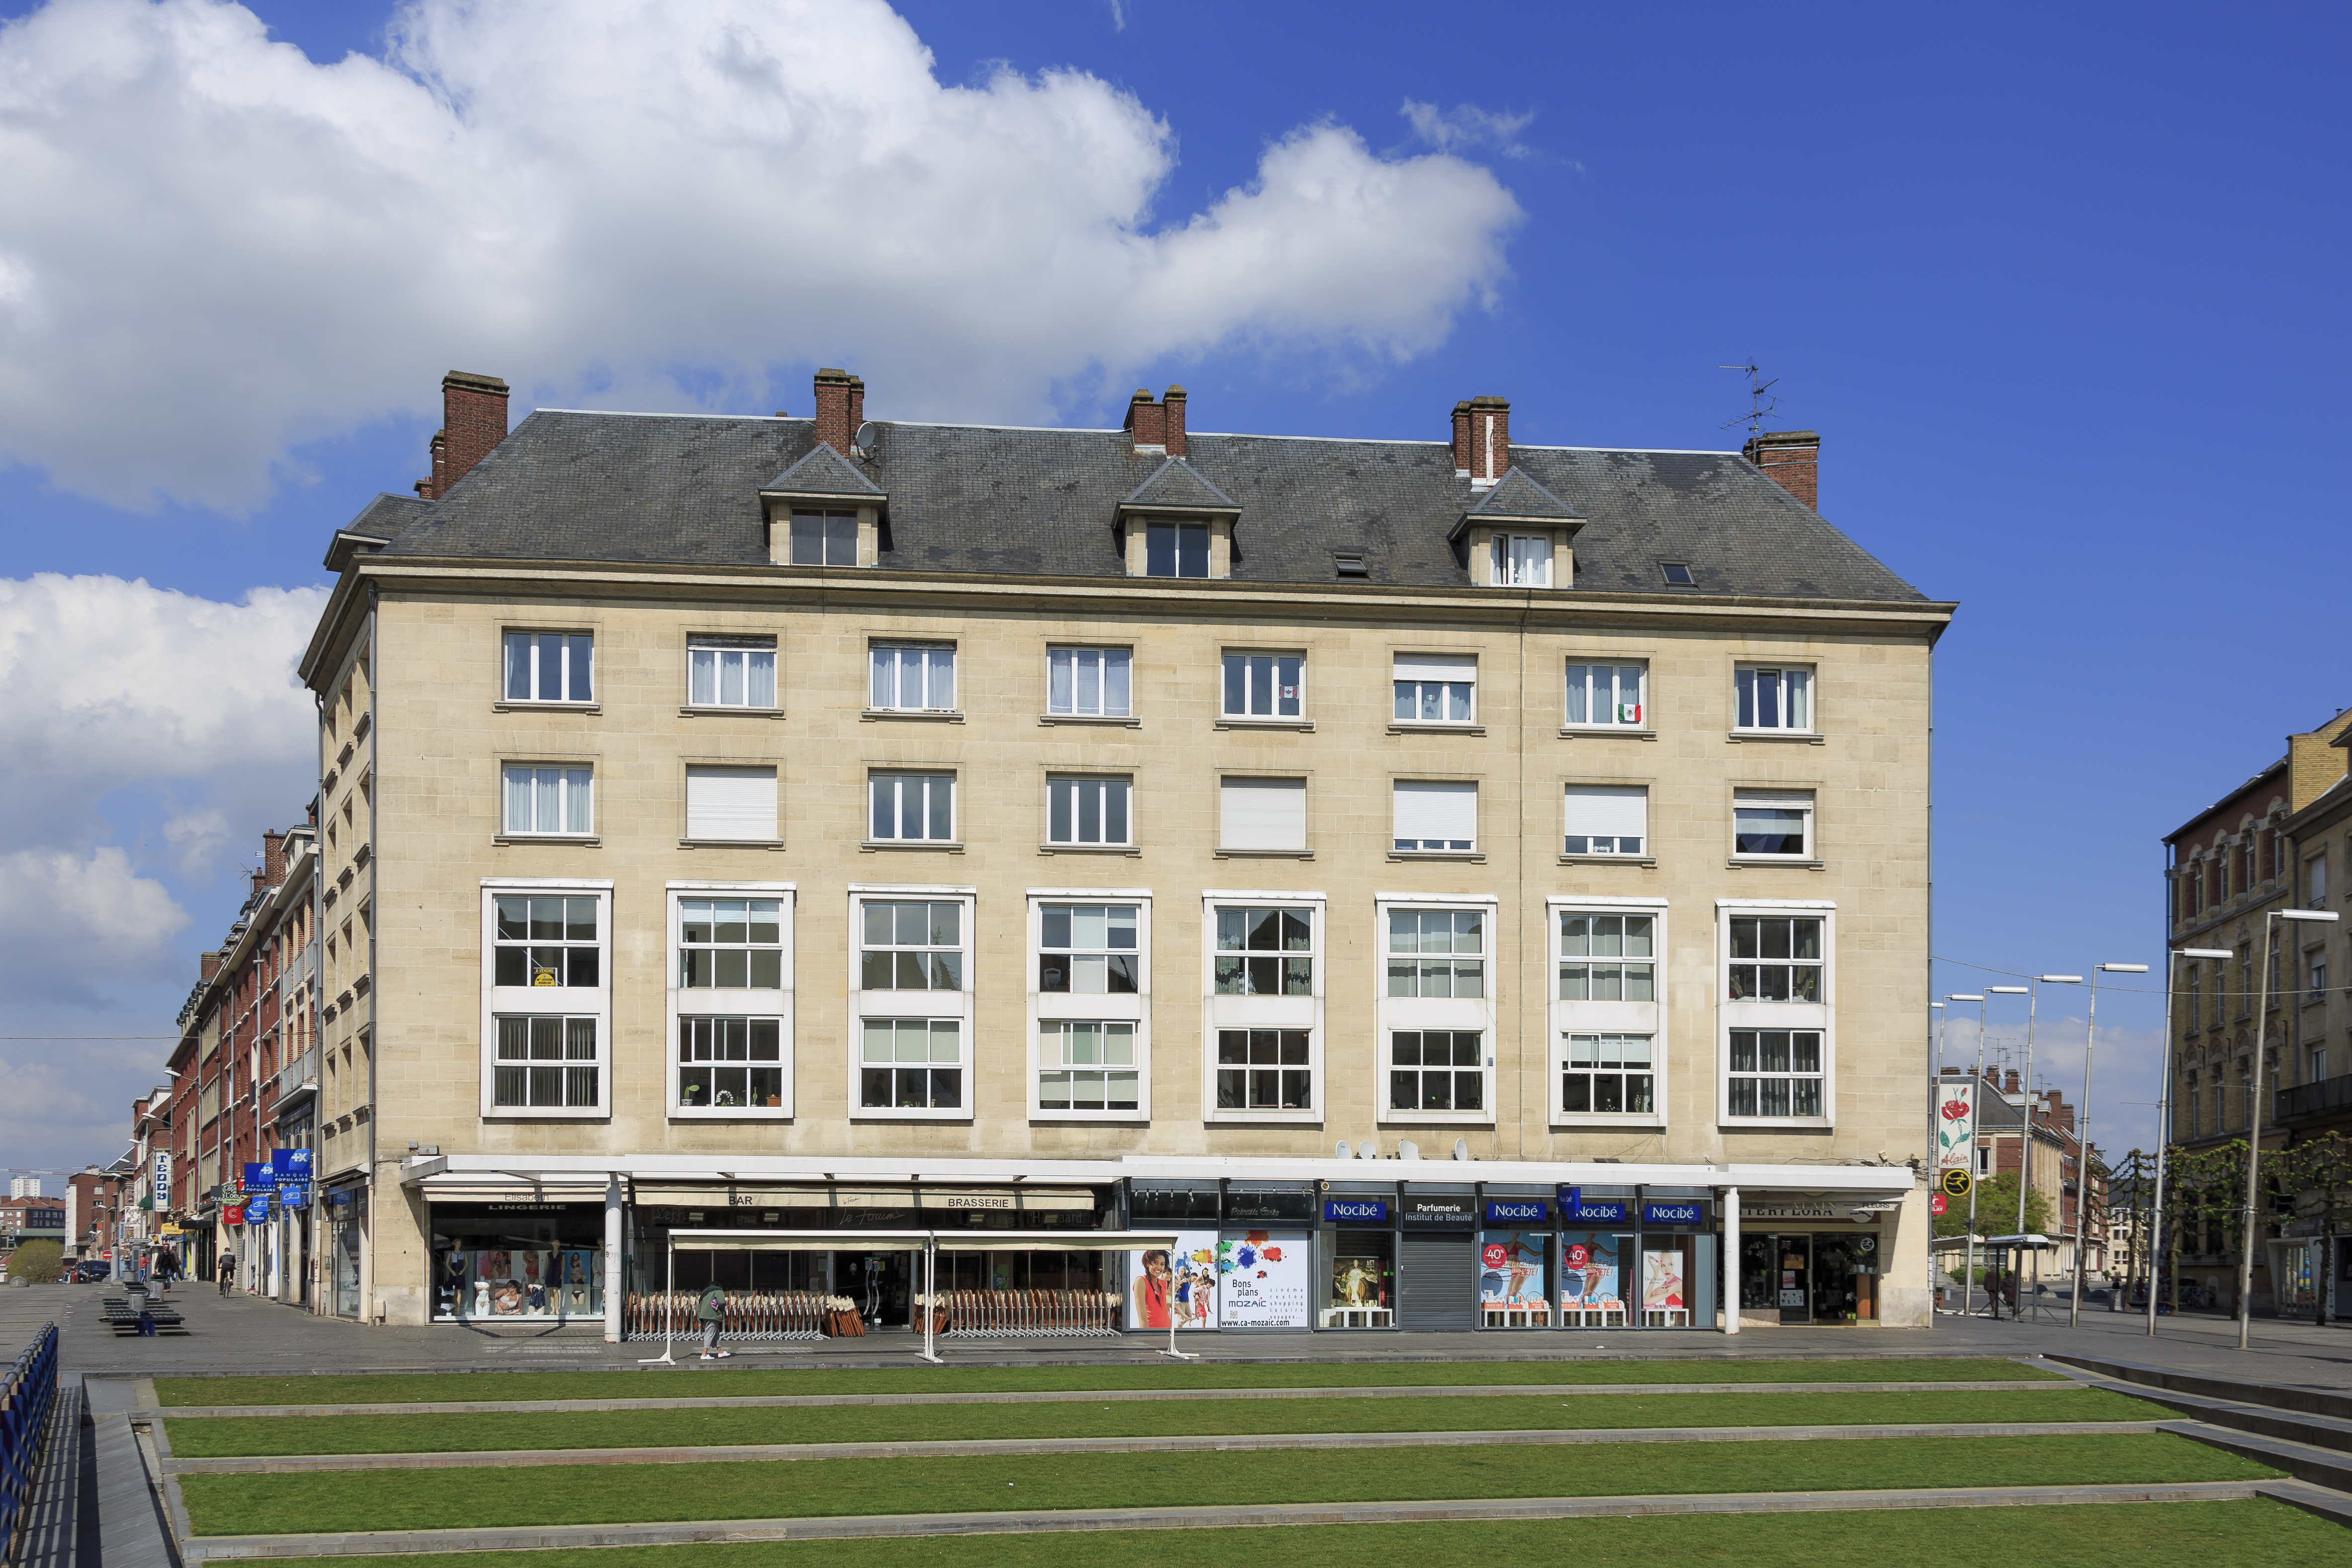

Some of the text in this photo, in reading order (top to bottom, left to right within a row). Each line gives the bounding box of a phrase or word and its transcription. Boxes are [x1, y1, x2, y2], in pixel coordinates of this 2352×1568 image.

[1940, 1152, 1969, 1166] Alain
[729, 1196, 753, 1205] BAR
[948, 1198, 1009, 1208] BRASSERIE
[1791, 1201, 1837, 1210] ALAIN
[1333, 1203, 1377, 1216] Nocibé
[1495, 1205, 1538, 1217] Nocibé
[1576, 1206, 1617, 1217] Nocibé
[1653, 1207, 1694, 1219] Nocibé
[839, 1207, 905, 1225] Le Forum
[1232, 1279, 1251, 1288] Bons
[1238, 1288, 1258, 1298] plans
